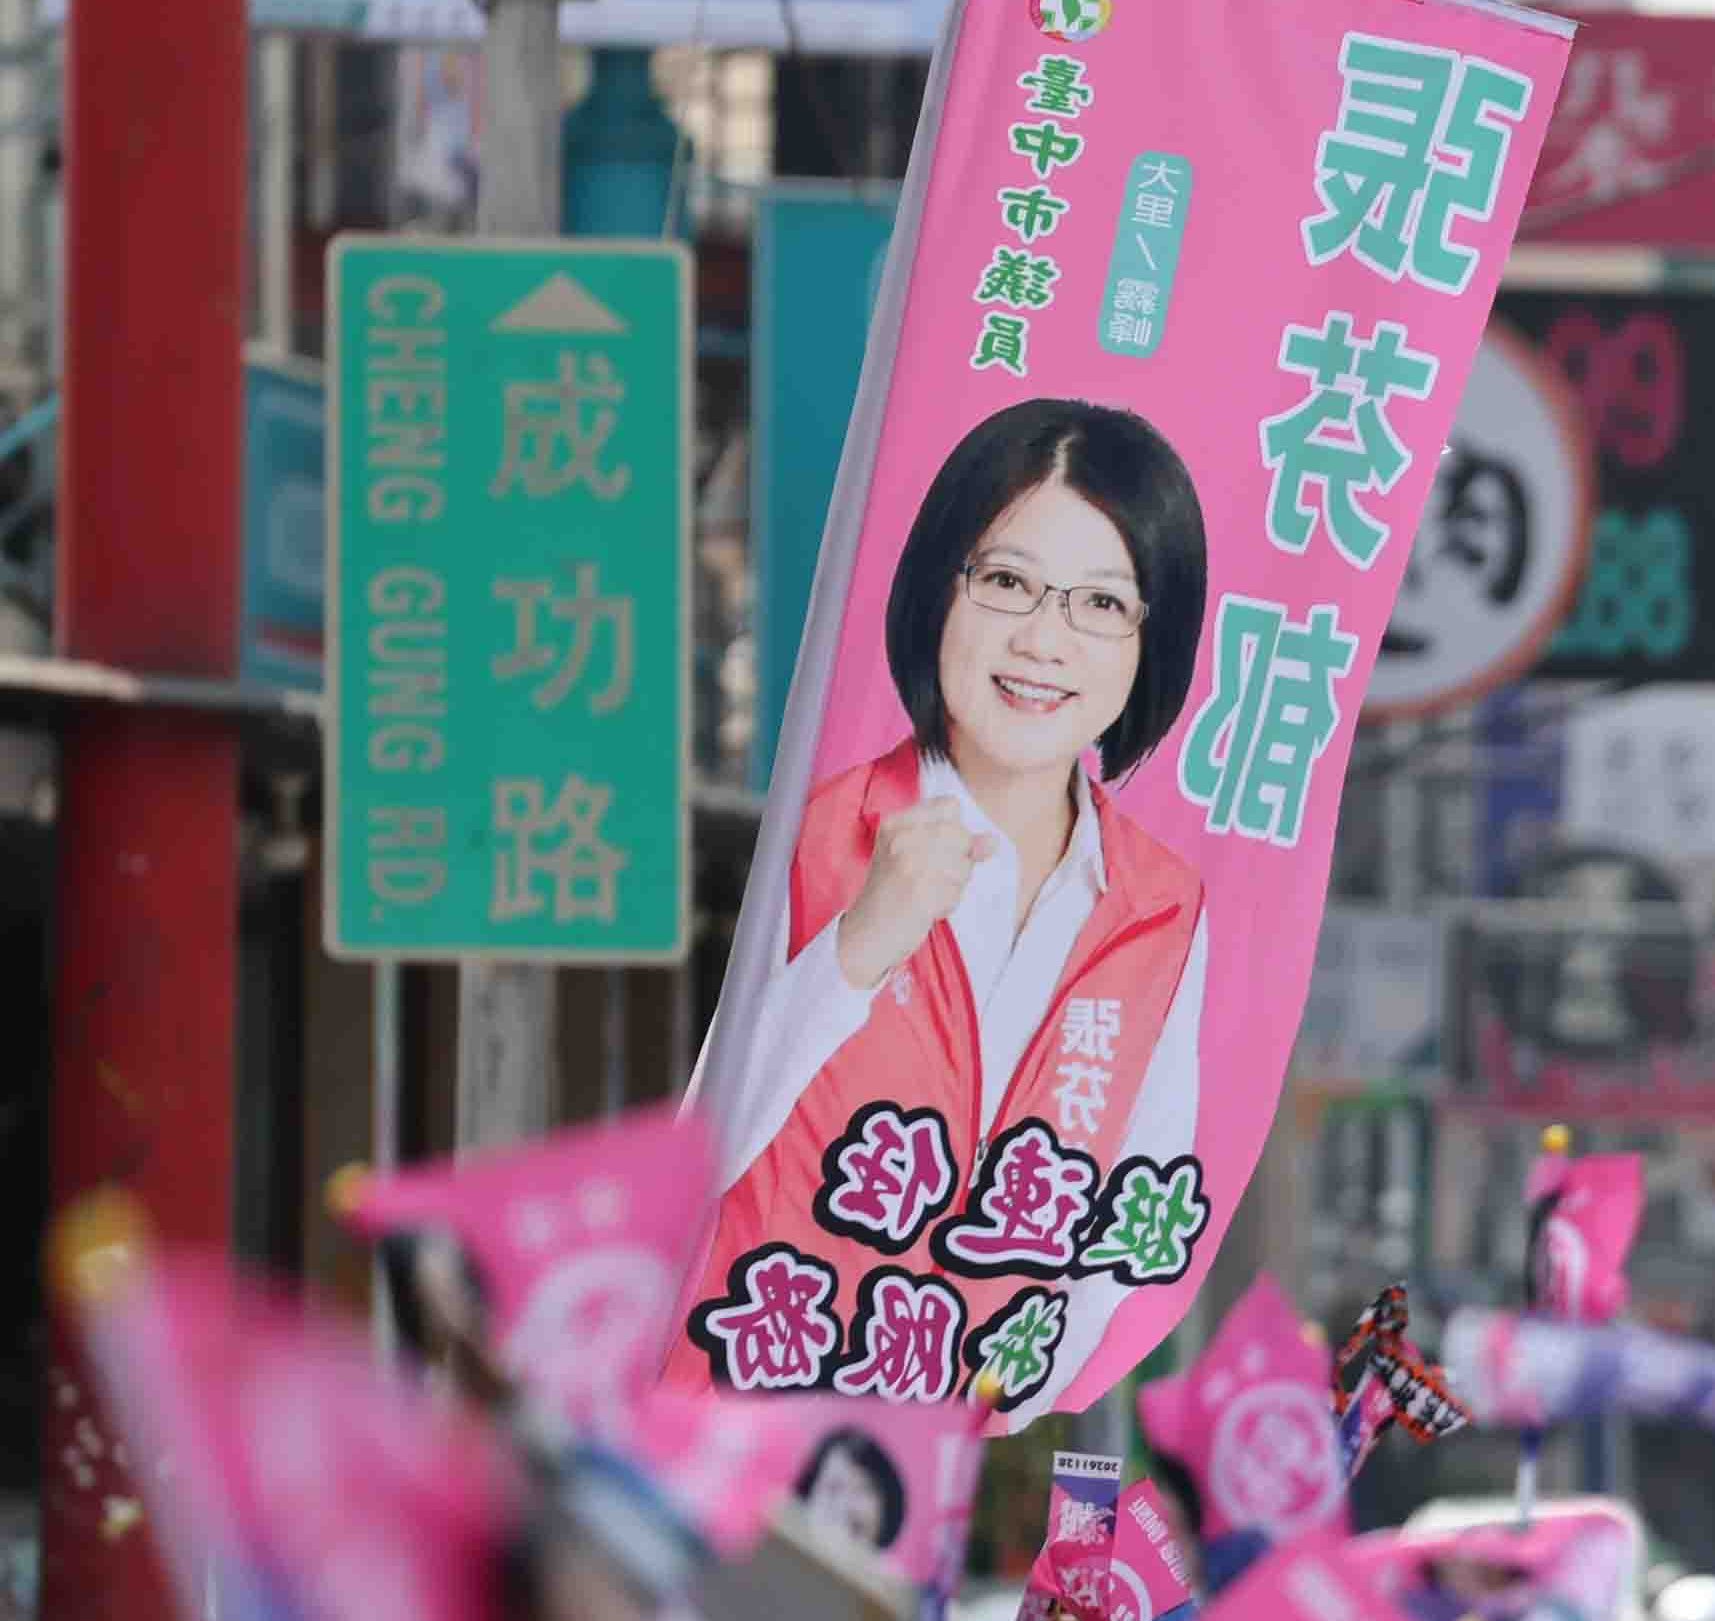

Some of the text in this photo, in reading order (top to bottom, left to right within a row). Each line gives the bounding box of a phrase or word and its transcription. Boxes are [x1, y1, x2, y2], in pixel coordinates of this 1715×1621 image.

[366, 273, 446, 522] CHENG
[366, 567, 446, 775] GUNG
[487, 353, 635, 925] 成功路
